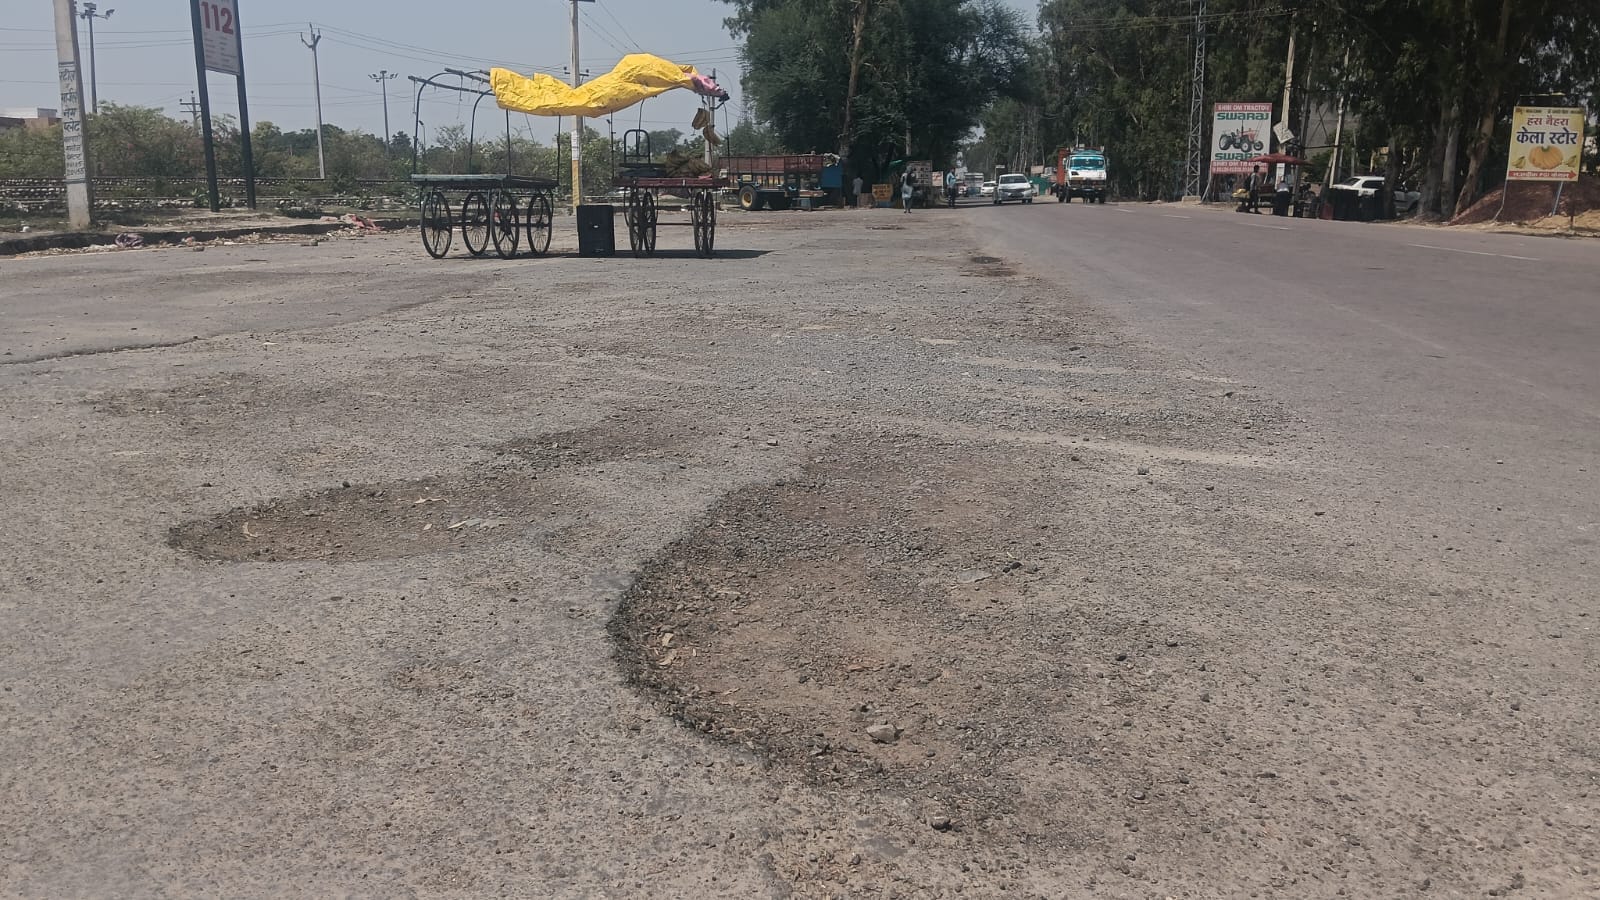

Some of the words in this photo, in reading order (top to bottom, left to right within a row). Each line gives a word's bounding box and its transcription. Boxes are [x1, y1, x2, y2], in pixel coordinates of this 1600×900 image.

[201, 1, 234, 35] 112
[1516, 126, 1546, 144] केला
[1549, 127, 1578, 144] स्टोर
